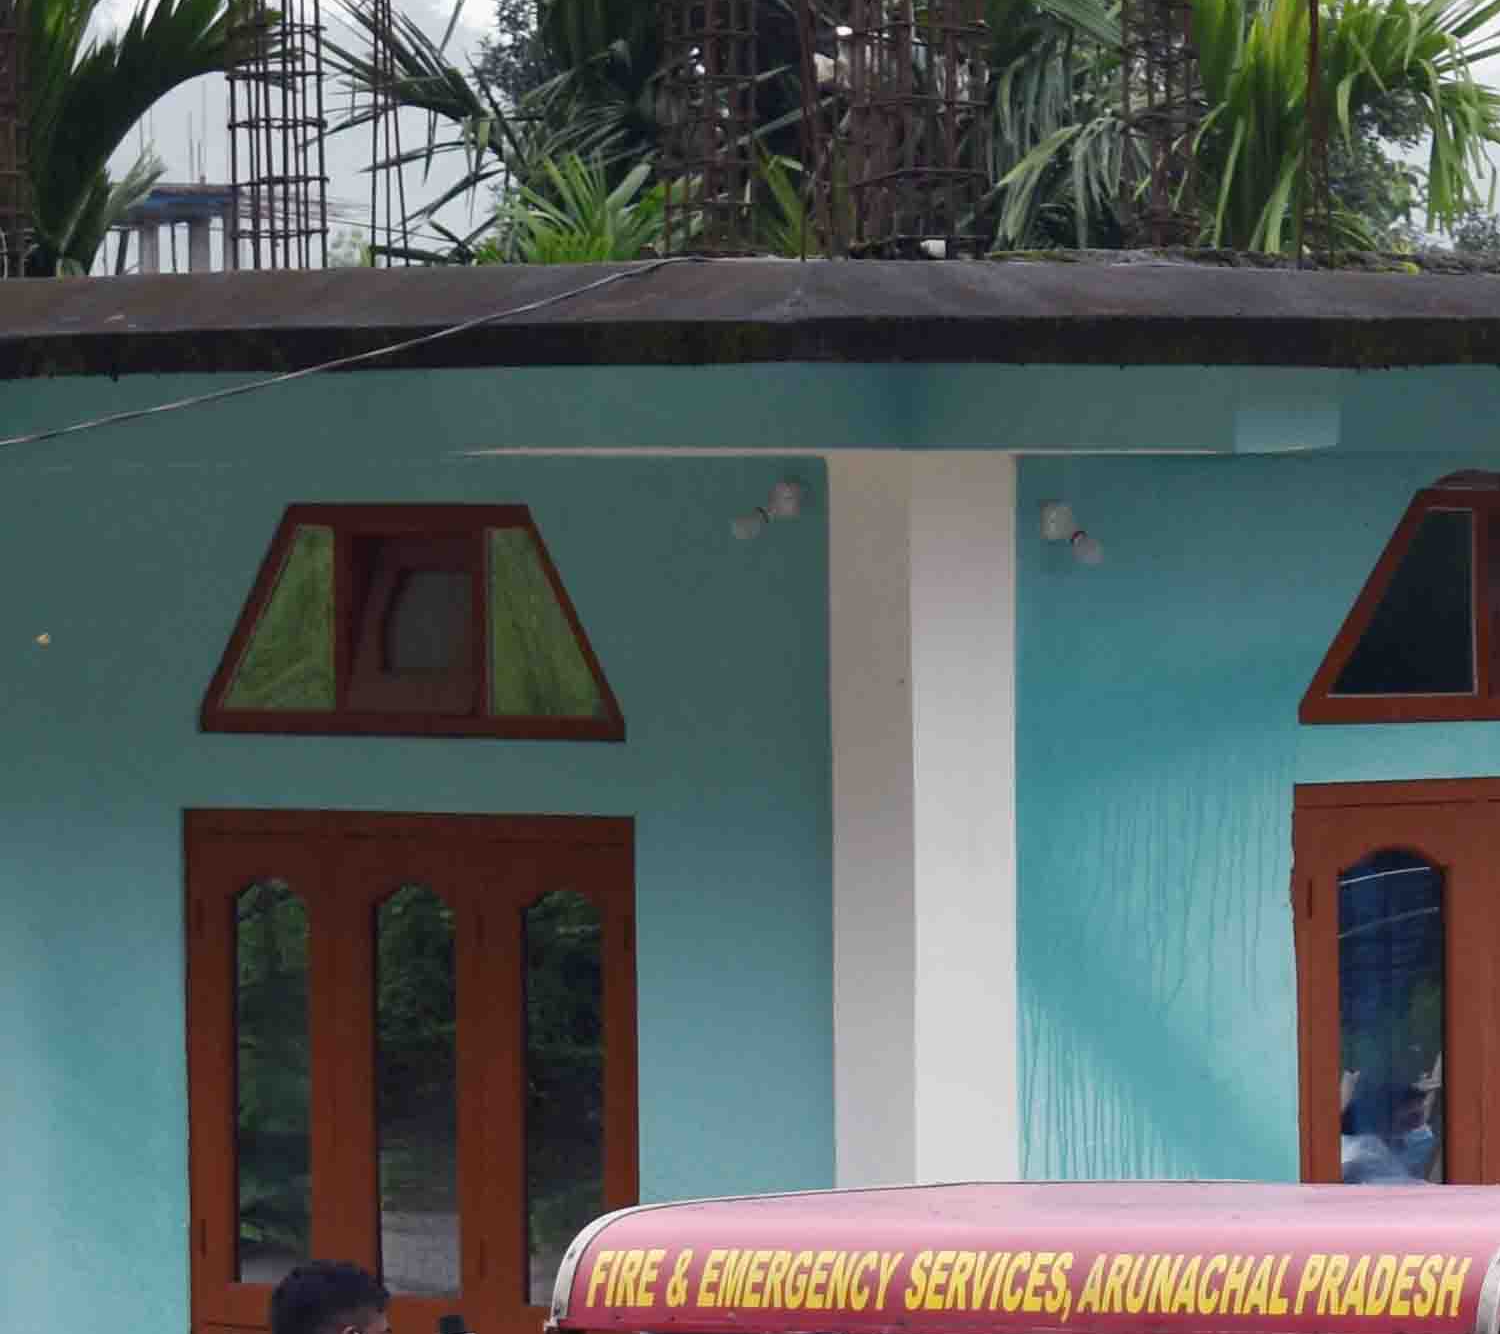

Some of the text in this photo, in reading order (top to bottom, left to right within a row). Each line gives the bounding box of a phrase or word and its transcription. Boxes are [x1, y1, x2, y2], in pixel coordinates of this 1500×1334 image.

[586, 1249, 1472, 1323] FIRE & EMERGENCY SERVICES, ARUNACHAL PRADESH
